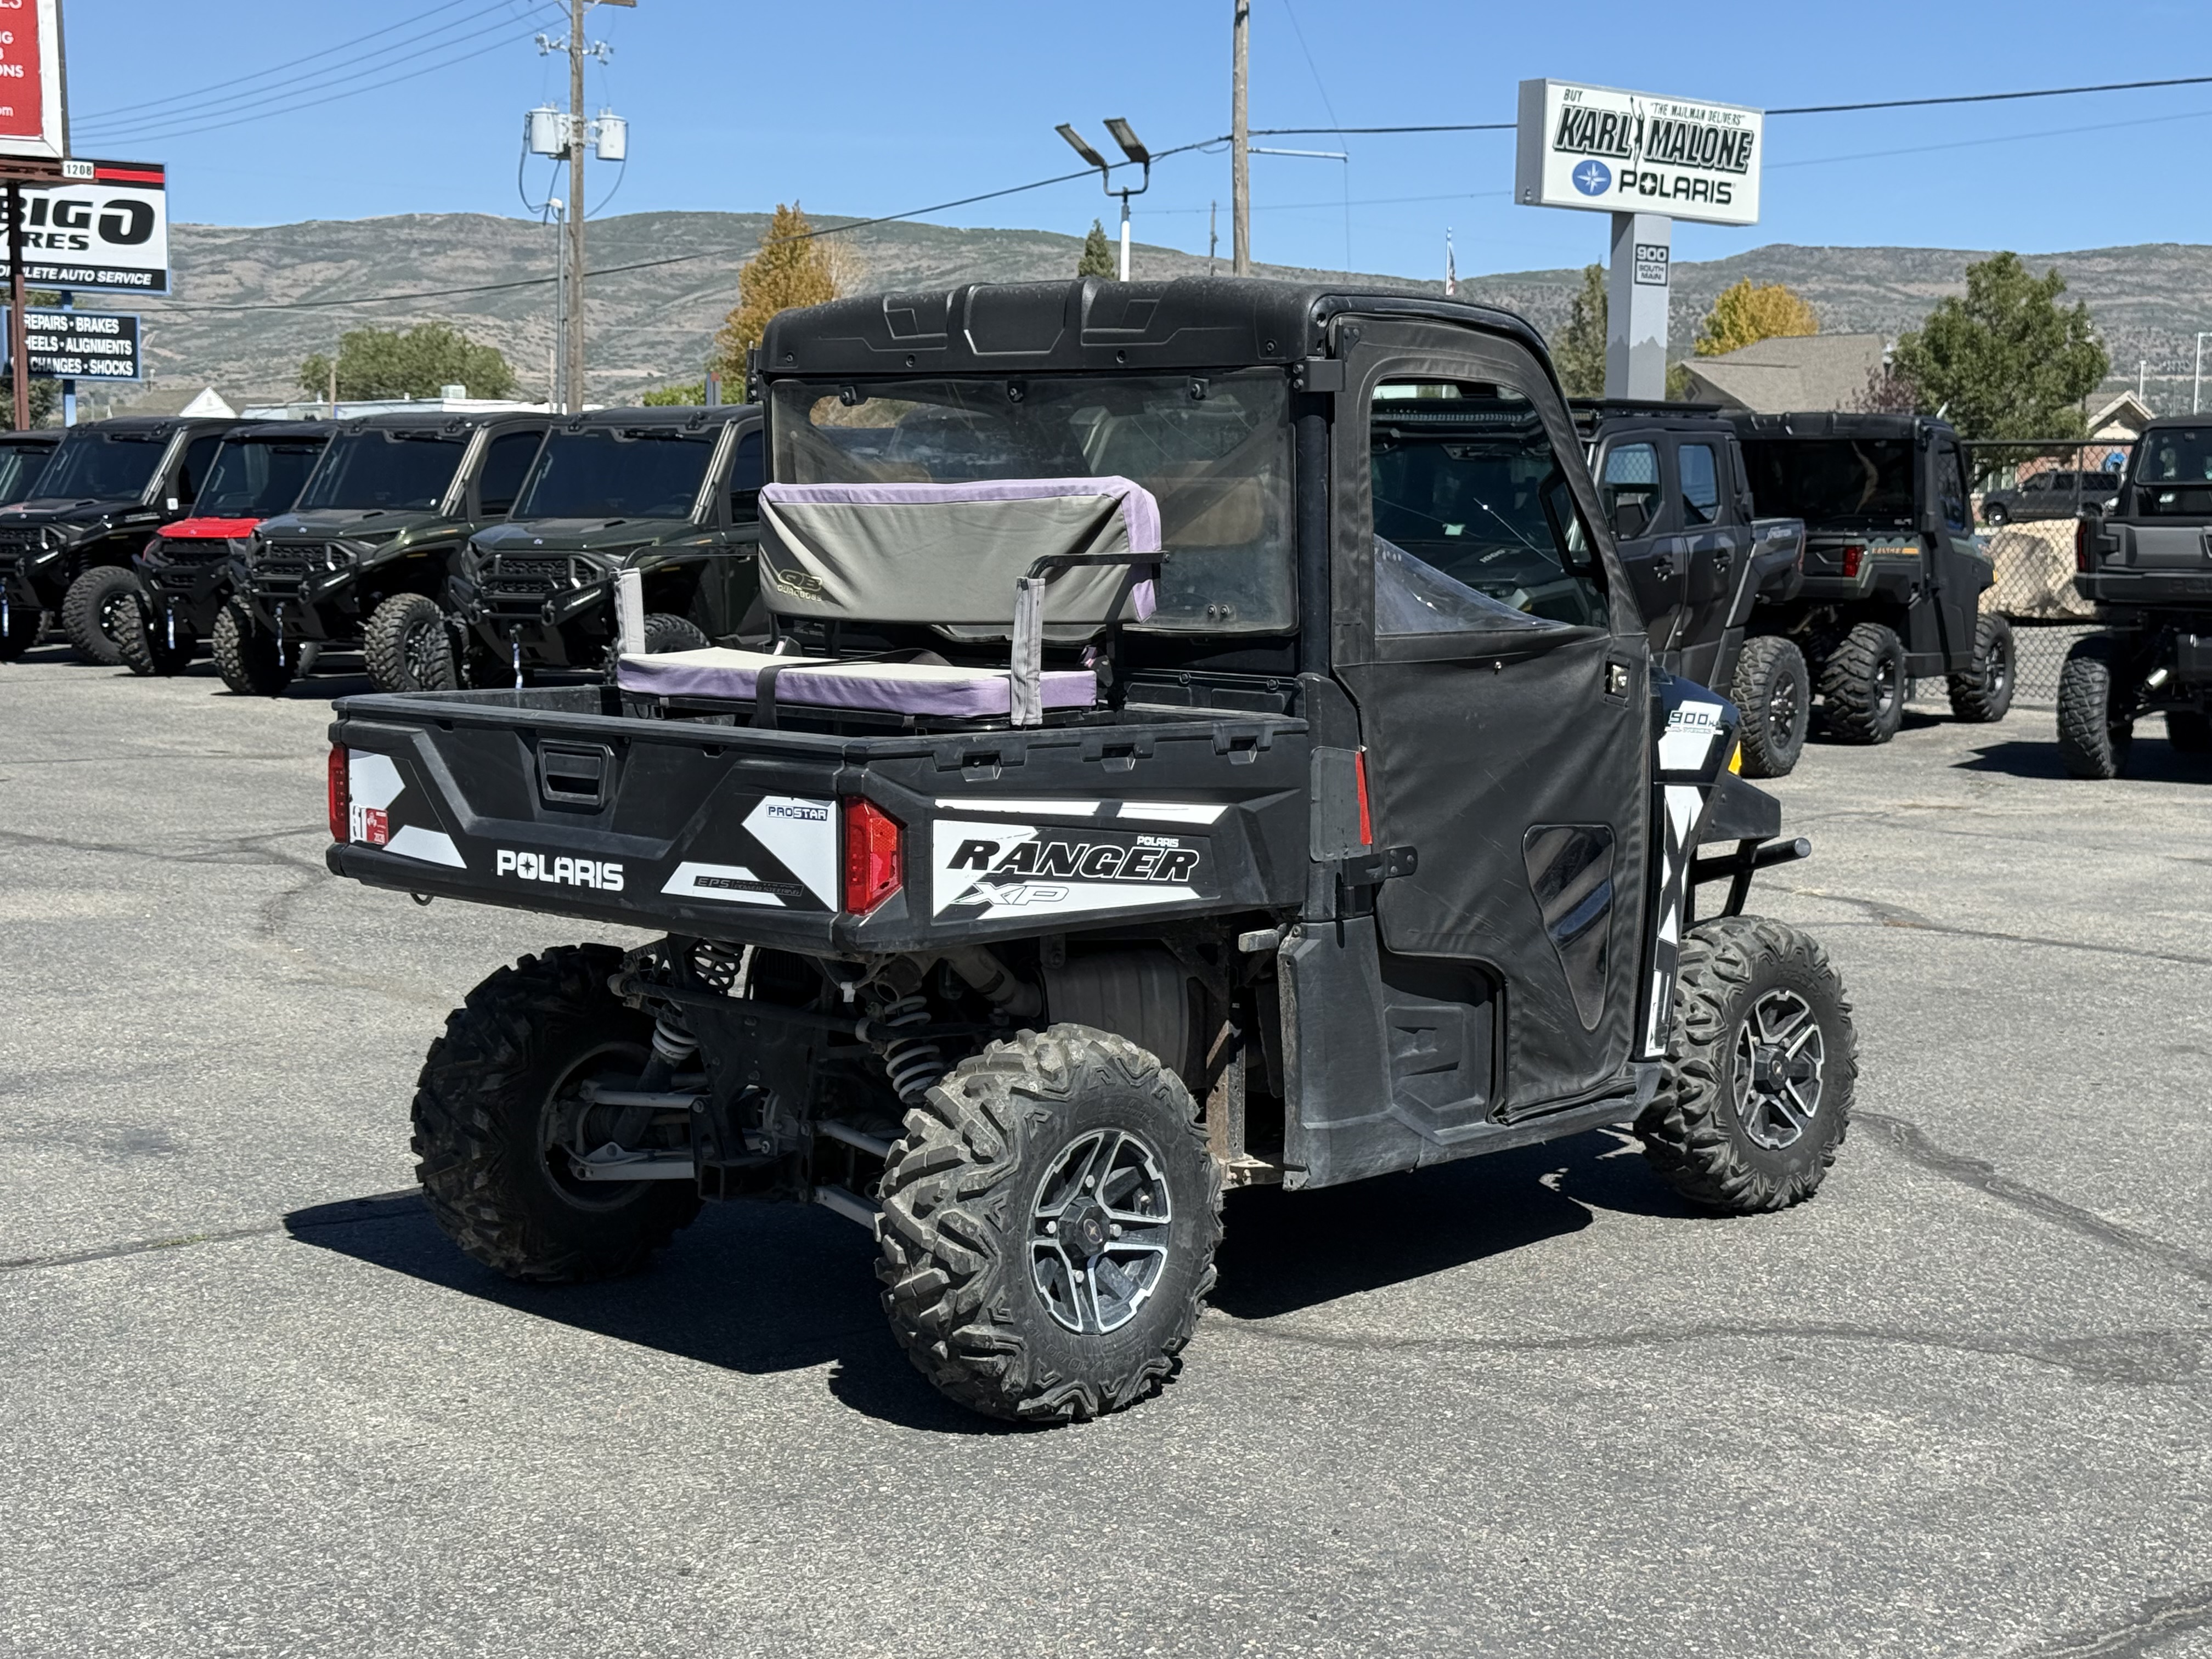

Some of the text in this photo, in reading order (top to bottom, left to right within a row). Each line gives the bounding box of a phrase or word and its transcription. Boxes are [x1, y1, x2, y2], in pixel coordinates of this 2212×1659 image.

[0, 64, 24, 78] NS
[1564, 88, 1583, 102] BUY
[1670, 105, 1706, 121] MAILMAN
[1553, 104, 1754, 175] KARL MALONE
[66, 164, 92, 176] 1208
[1619, 169, 1733, 205] POLARIS
[98, 199, 155, 245] O
[1637, 246, 1667, 261] 900
[1639, 264, 1664, 273] SOUTH
[1641, 272, 1662, 280] MAIN
[59, 268, 95, 282] AUTO
[96, 270, 152, 286] SERVICE
[75, 317, 120, 334] BRAKES
[24, 335, 132, 356] HEELS ALIGNMENTS
[30, 357, 82, 374] CHANGES
[89, 359, 133, 376] SHOCKS
[1668, 711, 1709, 725] 900
[768, 806, 827, 820] PROSTAR
[1137, 836, 1179, 848] POLARIS
[946, 839, 1200, 882] RANGER
[497, 849, 624, 891] POLARIS
[697, 877, 730, 888] EPS
[763, 887, 800, 895] STEERING
[950, 882, 1069, 906] XP
